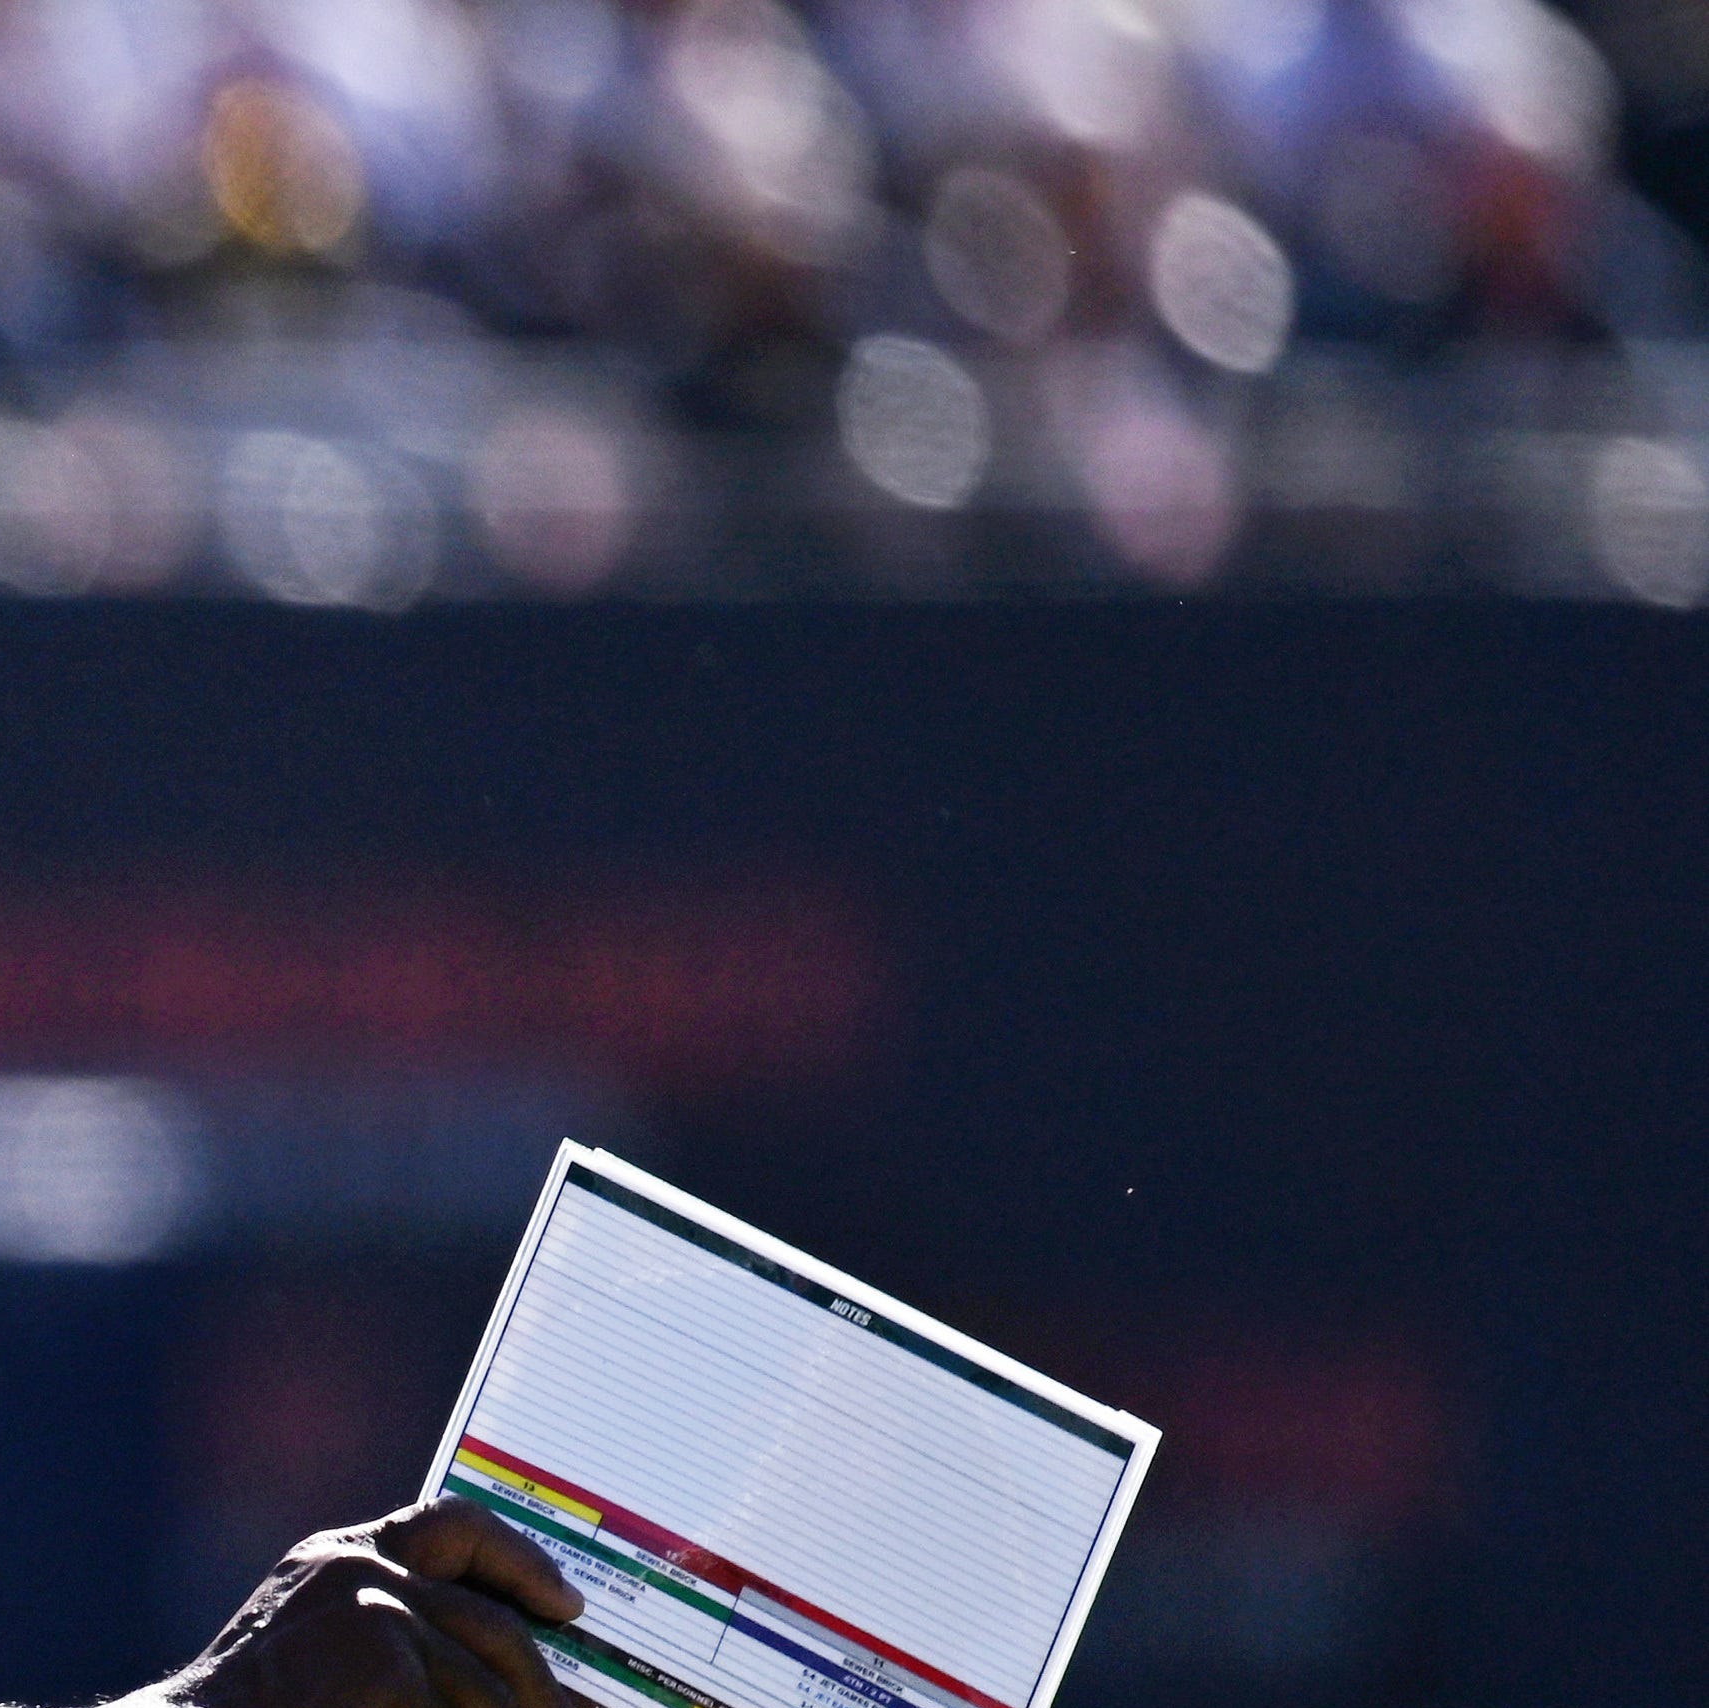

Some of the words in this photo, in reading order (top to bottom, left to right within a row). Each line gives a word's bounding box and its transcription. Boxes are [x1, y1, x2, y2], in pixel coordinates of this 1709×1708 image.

[831, 1299, 872, 1327] NOTES
[491, 1481, 524, 1503] SEWER
[527, 1498, 555, 1517] BRICK
[540, 1536, 557, 1550] JET
[559, 1545, 592, 1566] GAMES
[595, 1561, 613, 1576] RED
[615, 1571, 646, 1592] KOREA
[670, 1567, 697, 1586] BRICK
[573, 1567, 605, 1588] SEWER
[608, 1584, 635, 1603] BRICK
[551, 1651, 579, 1670] TEXAS
[842, 1657, 874, 1679] SEWER
[876, 1674, 902, 1693] BRICK
[627, 1658, 655, 1677] MISC.
[657, 1674, 715, 1708] PERSONNEL
[815, 1691, 830, 1704] JET
[820, 1678, 836, 1691] JET
[837, 1687, 869, 1708] GAMES
